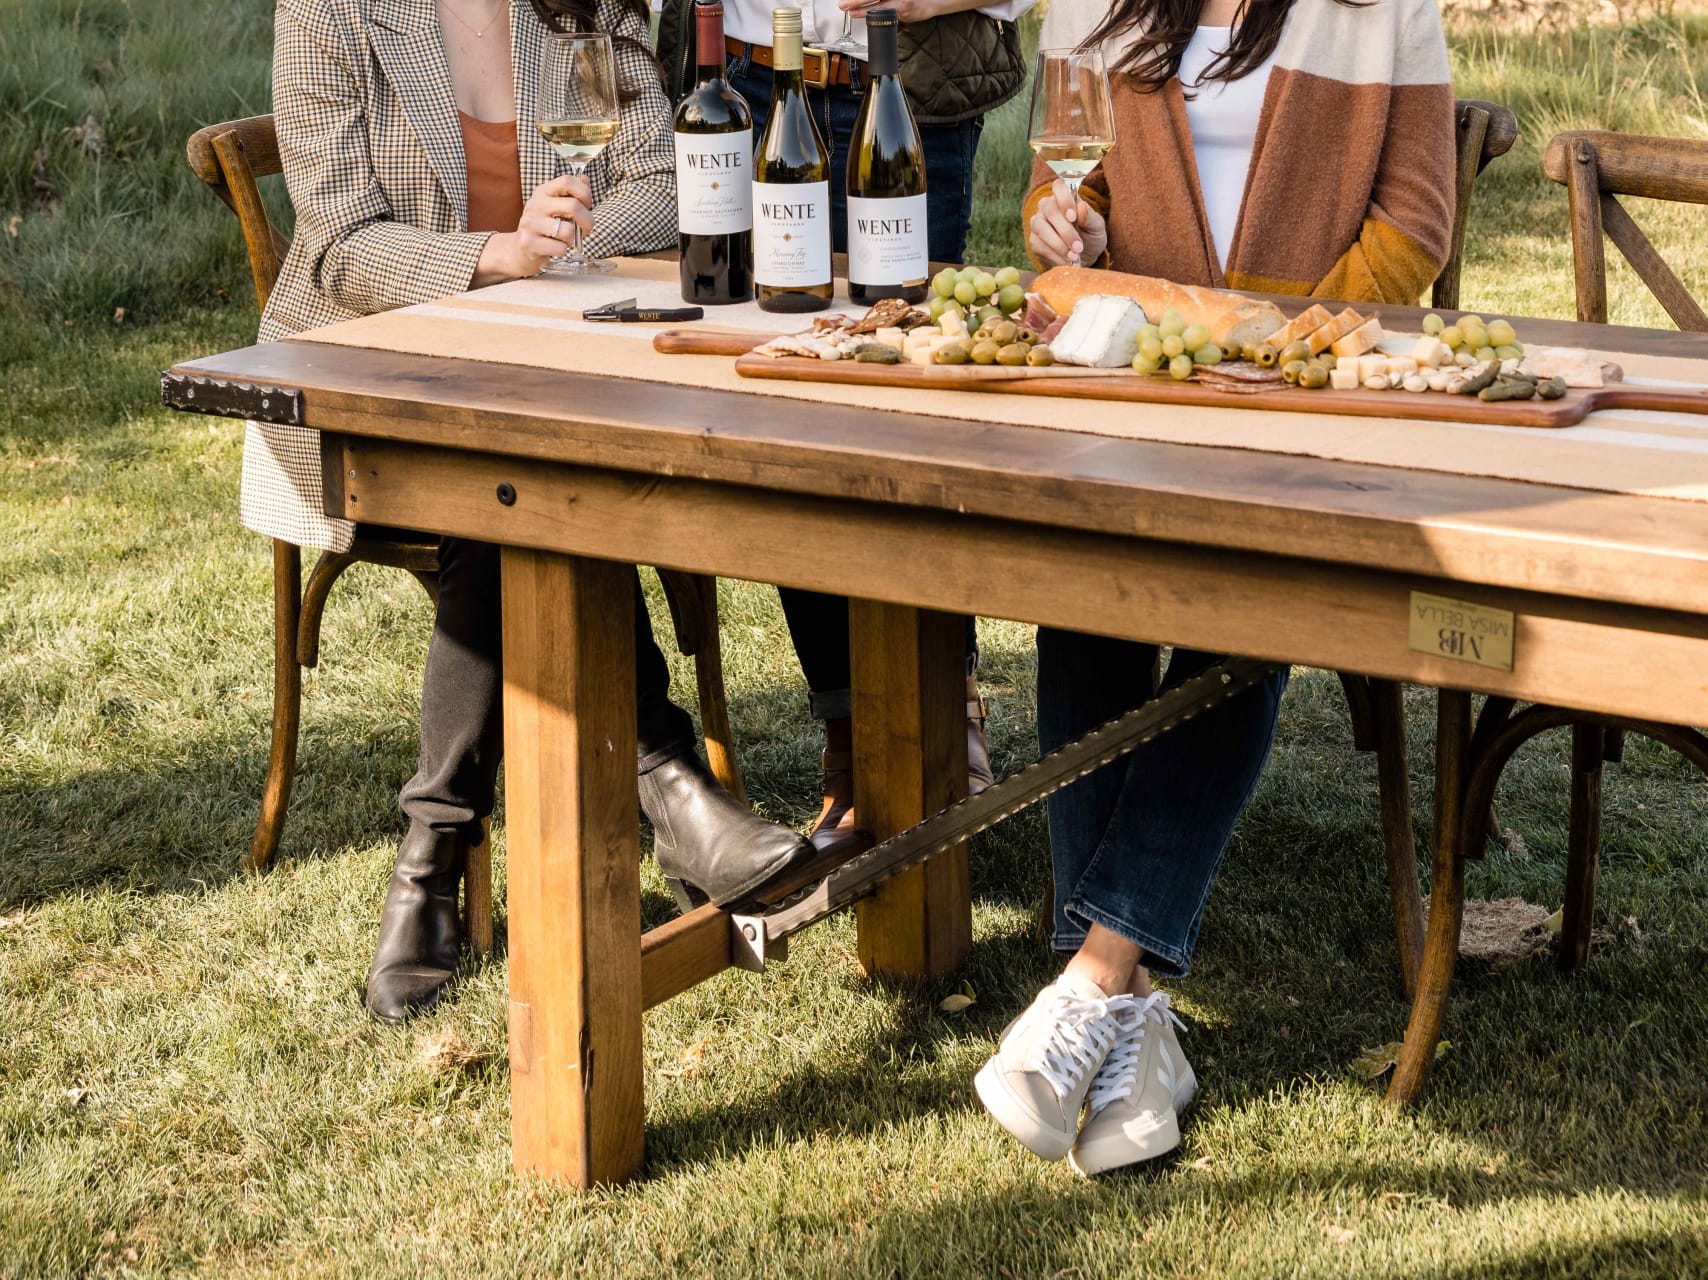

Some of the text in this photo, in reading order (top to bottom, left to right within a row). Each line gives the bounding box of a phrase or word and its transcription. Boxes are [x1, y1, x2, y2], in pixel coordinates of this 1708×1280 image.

[687, 152, 742, 169] WENTE
[761, 203, 816, 220] WENTE
[857, 218, 913, 235] WENTE
[639, 312, 660, 320] WENTE
[1416, 604, 1464, 628] BELLA
[1468, 616, 1509, 638] MISA
